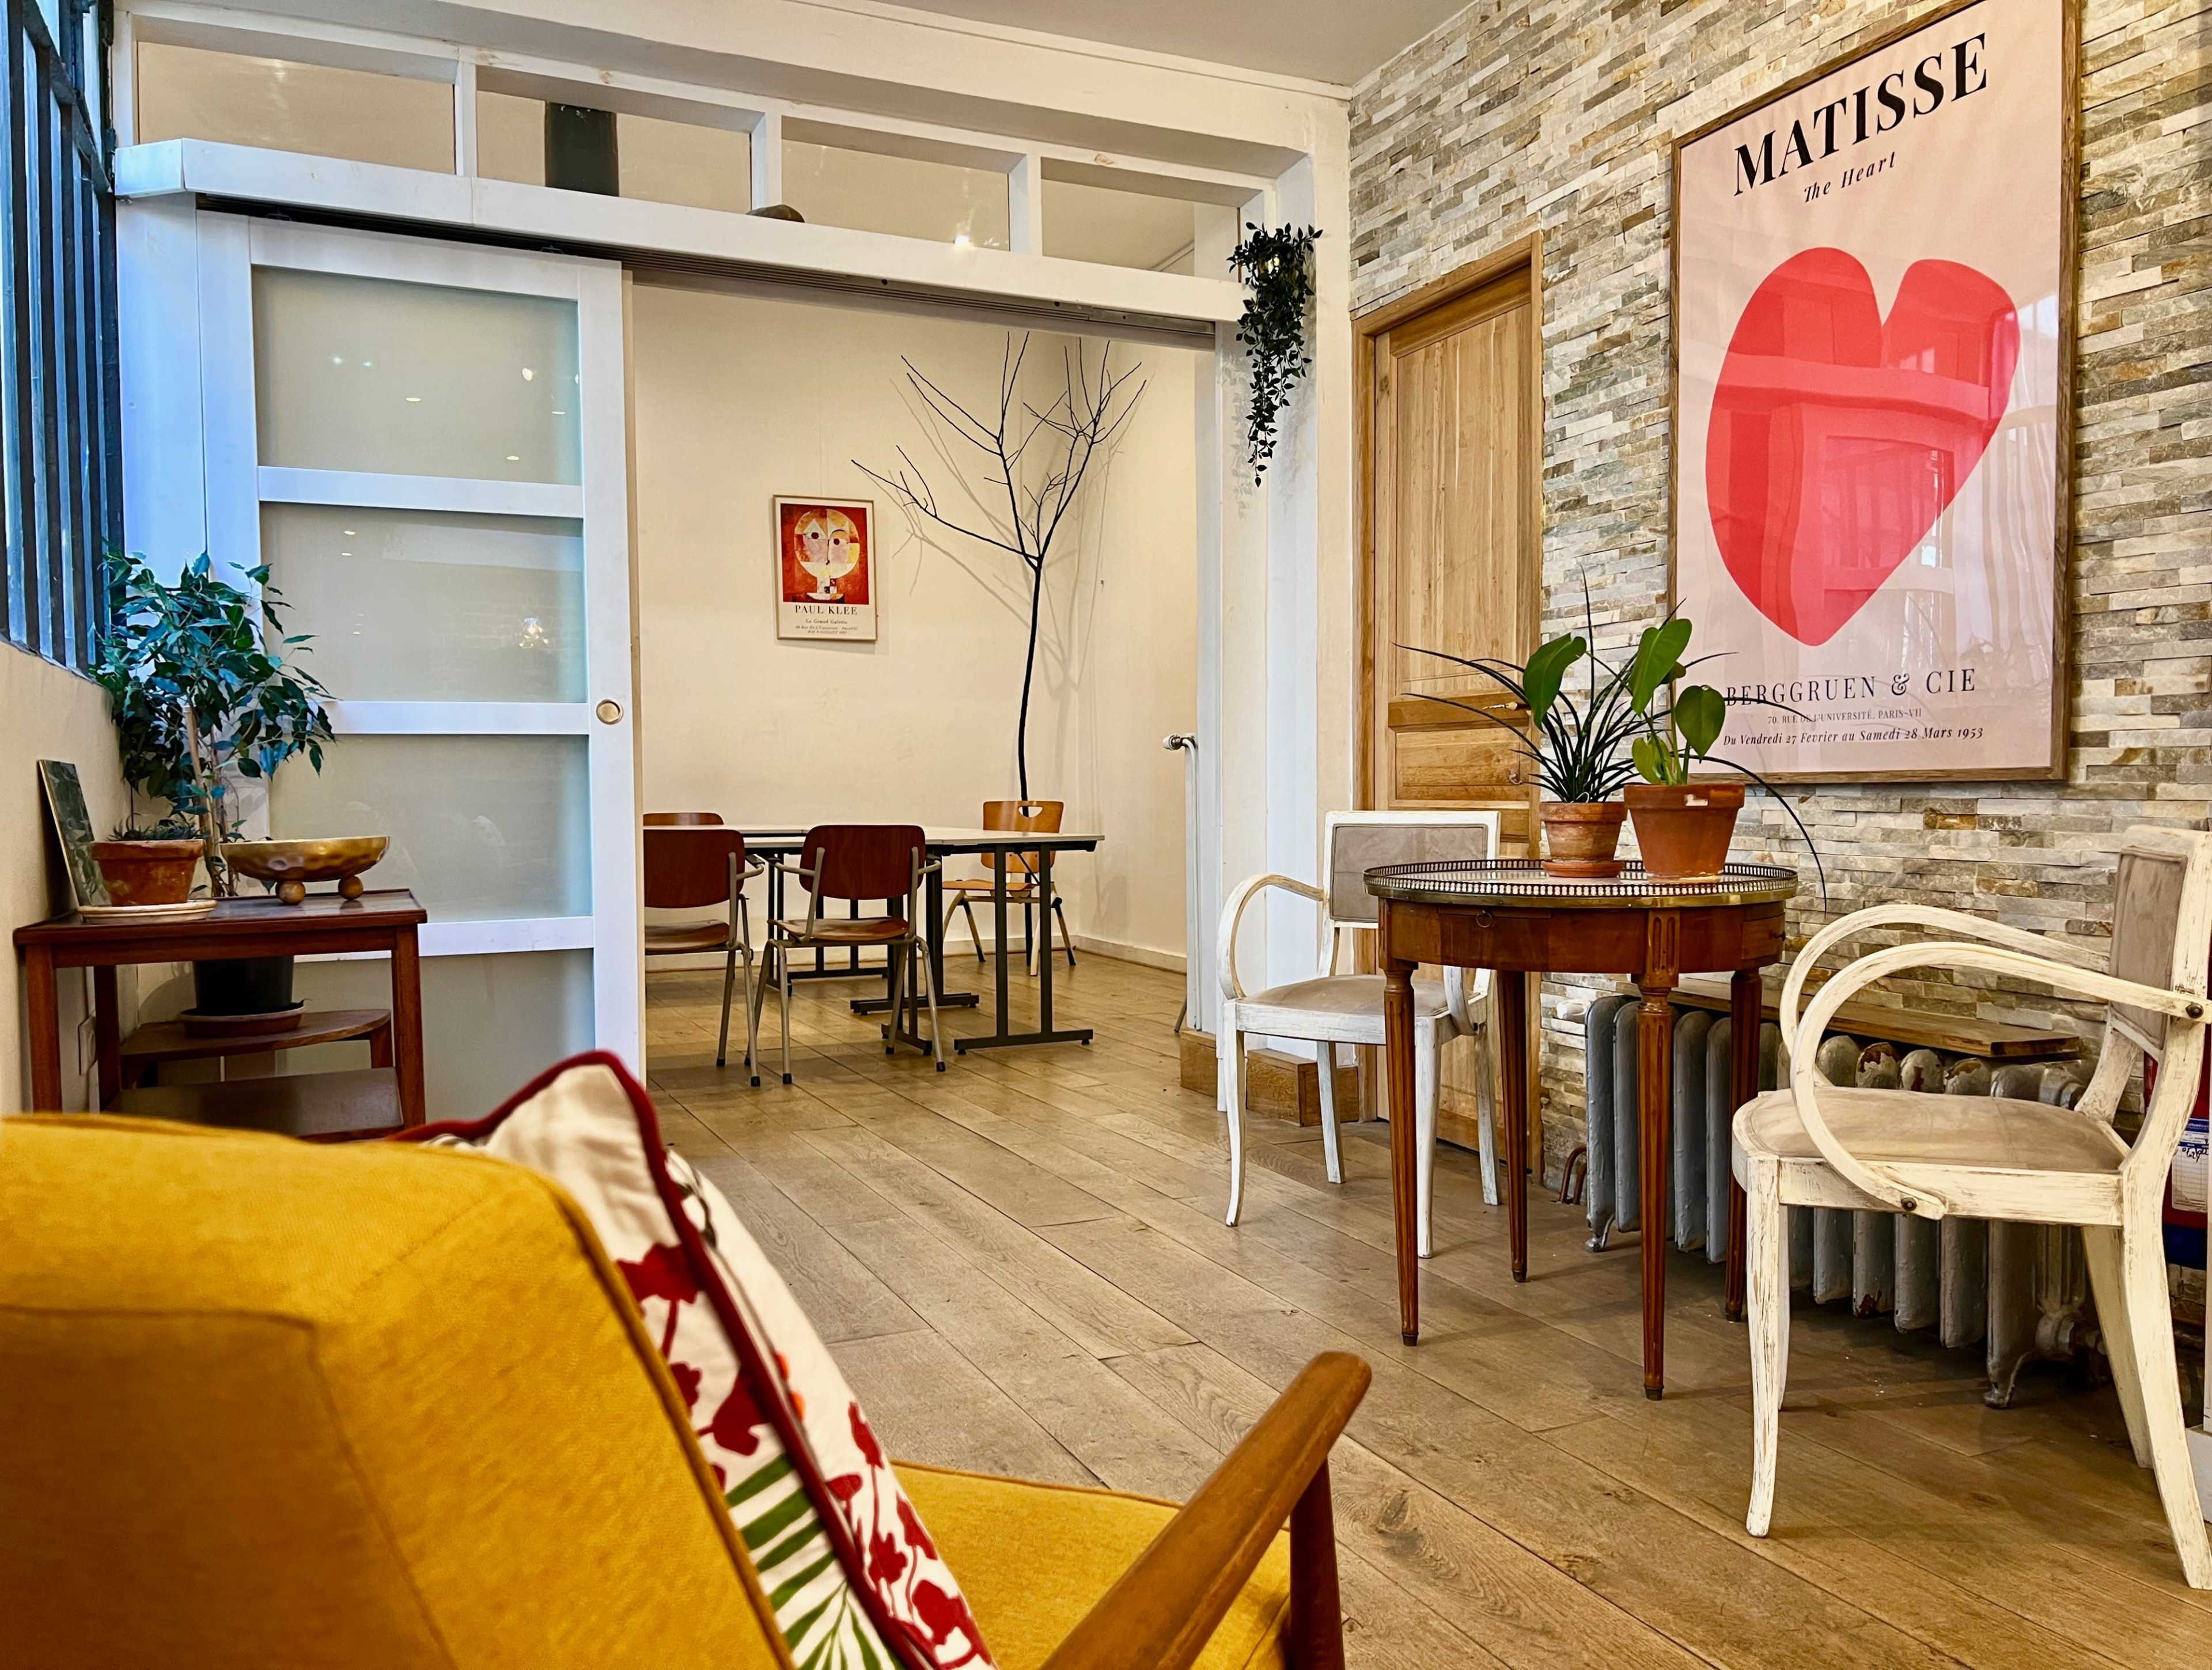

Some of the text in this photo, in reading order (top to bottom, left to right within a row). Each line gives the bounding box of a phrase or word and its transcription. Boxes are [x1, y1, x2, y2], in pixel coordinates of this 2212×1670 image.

[1734, 33, 1987, 196] MATISSE
[1804, 152, 1895, 202] The Heart
[796, 605, 857, 615] PAUL KLEE
[1726, 669, 1975, 706] BERGGRUEN & CIE
[1782, 715, 1797, 724] RUE
[1878, 709, 1922, 719] PARIS-VII
[1724, 727, 1983, 745] Du Vendredi 27 Fevrier au Samedi 28 Mars 1953
